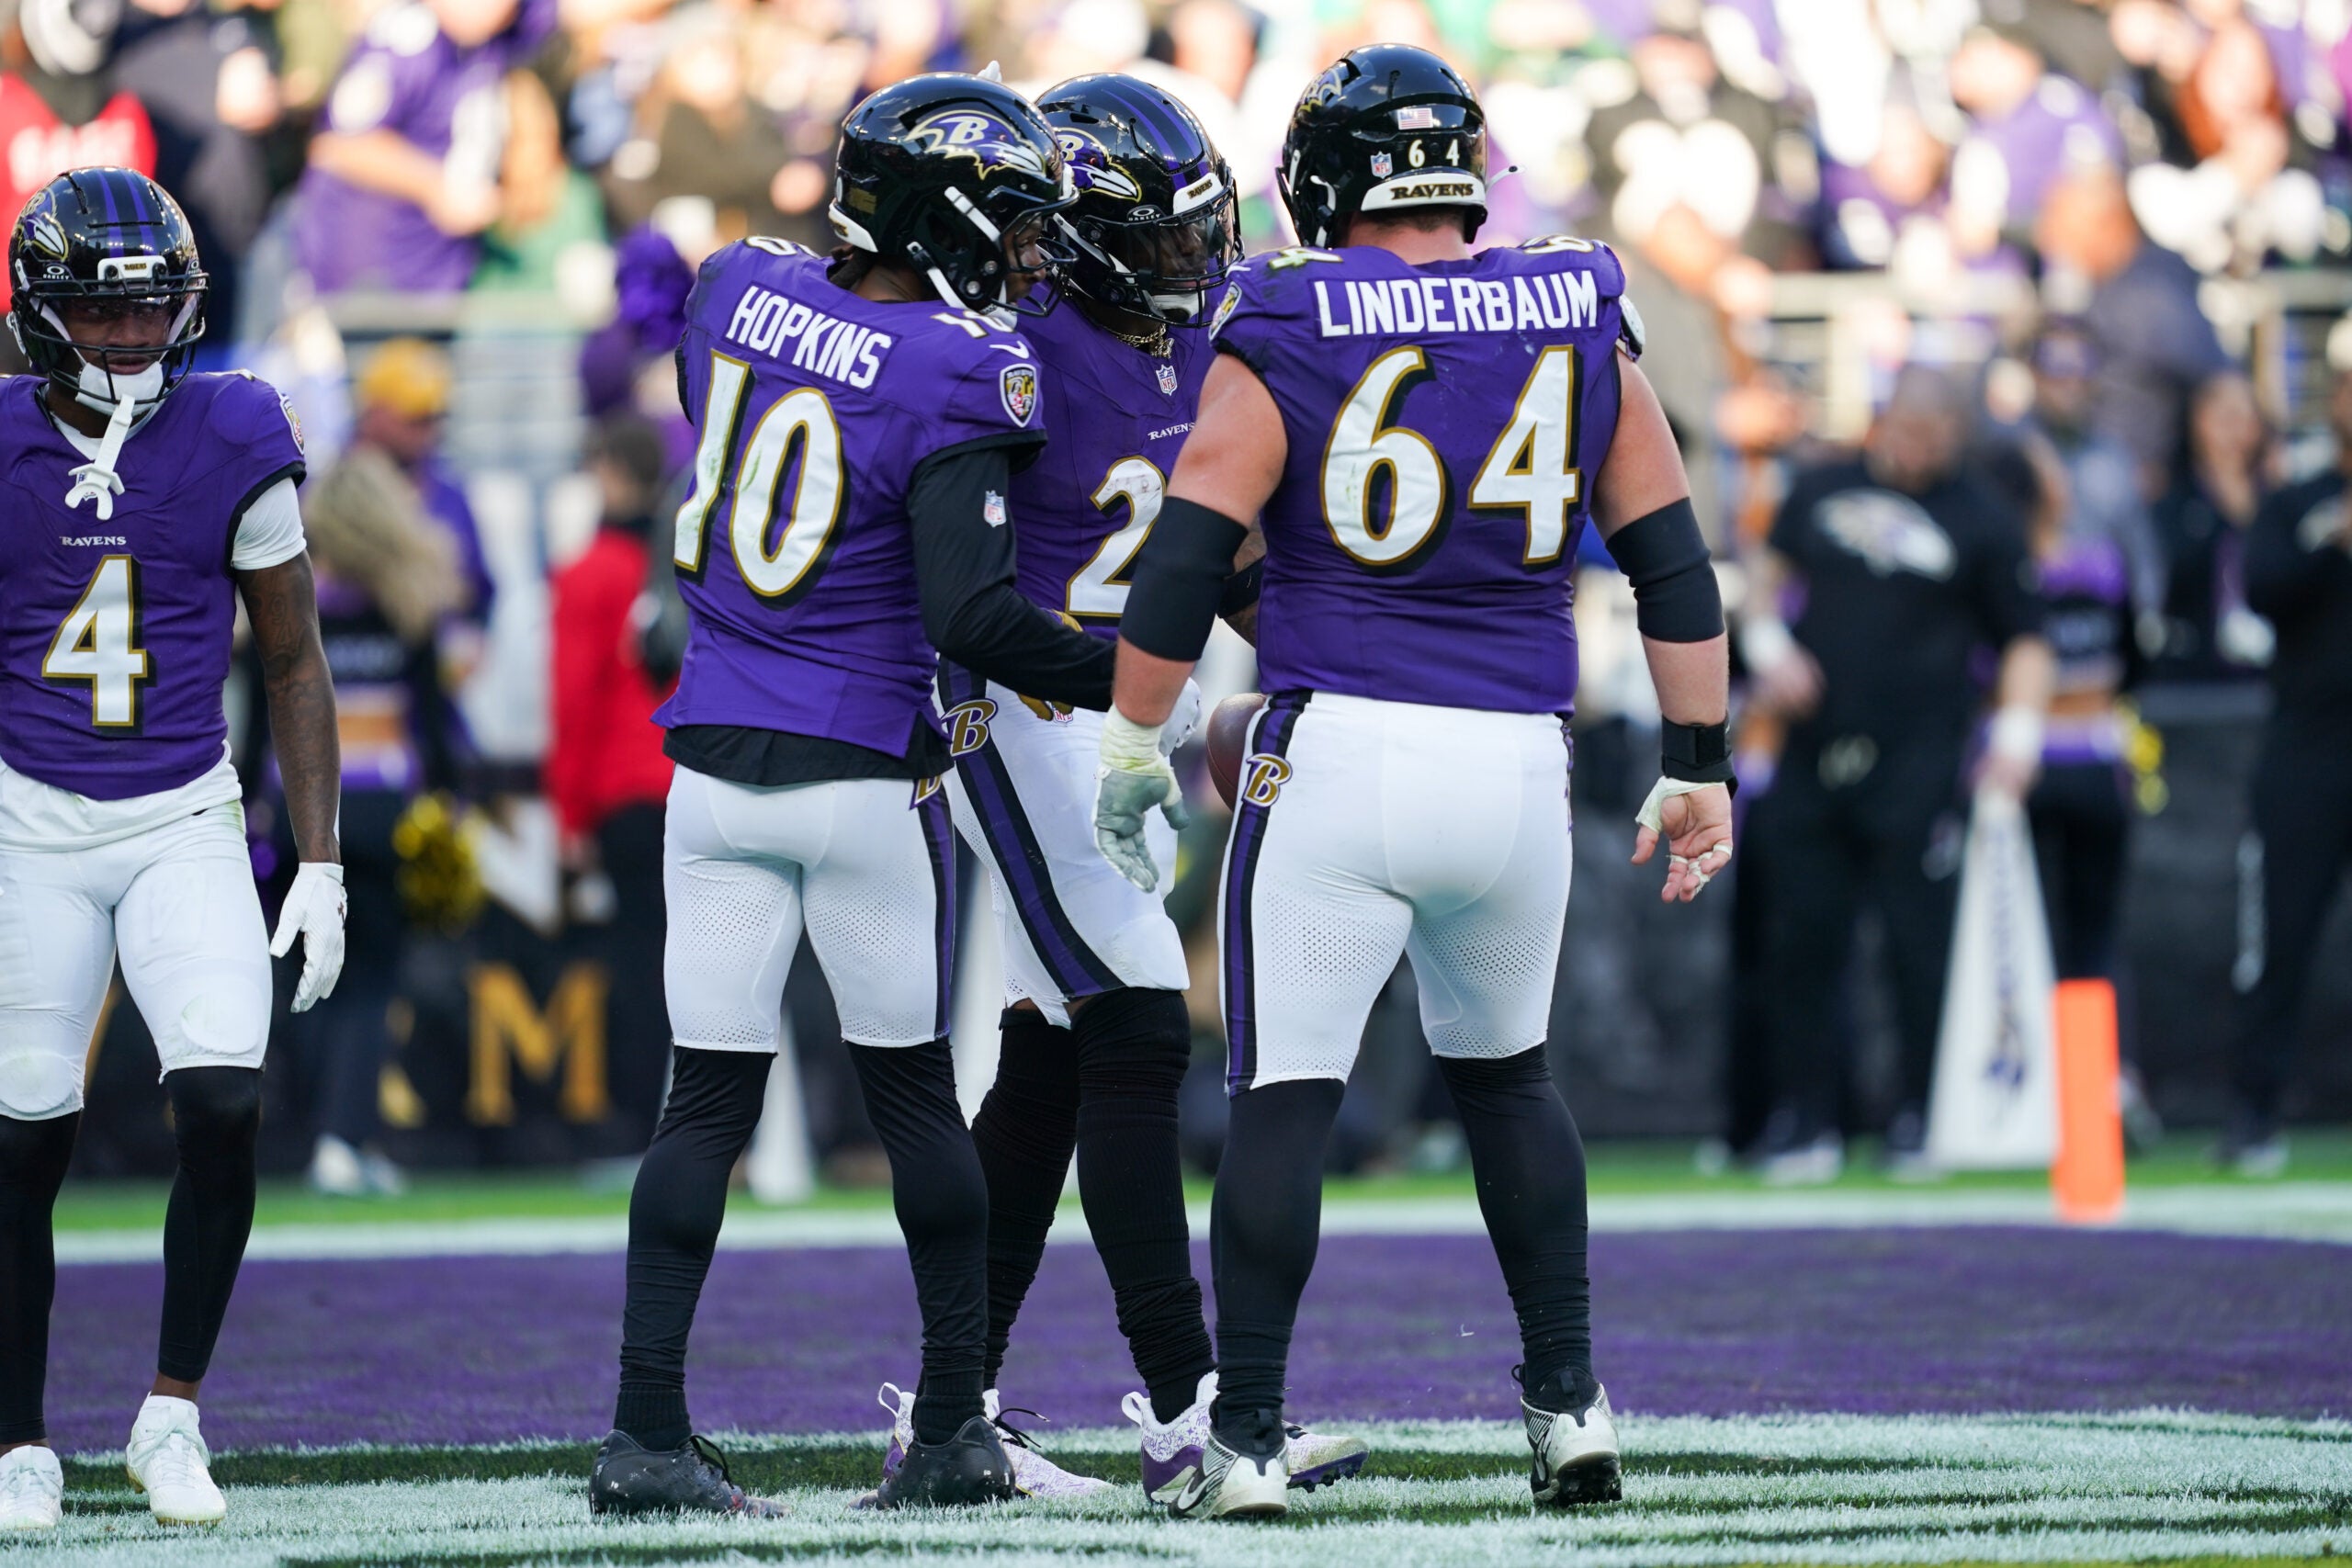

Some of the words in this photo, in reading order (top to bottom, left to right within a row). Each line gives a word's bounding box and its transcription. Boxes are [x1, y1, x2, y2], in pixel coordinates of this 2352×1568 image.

[1128, 213, 1160, 221] OAKLEY
[1390, 183, 1475, 200] RAVENS
[1314, 270, 1598, 338] LINDERBAUM
[725, 286, 892, 389] HOPKINS
[1148, 422, 1196, 441] RAVENS
[1319, 343, 1580, 566] 64
[673, 348, 844, 598] 10
[59, 536, 127, 547] RAVENS
[41, 554, 148, 727] 4
[943, 698, 998, 757] B
[1246, 752, 1293, 808] B
[465, 964, 610, 1126] M
